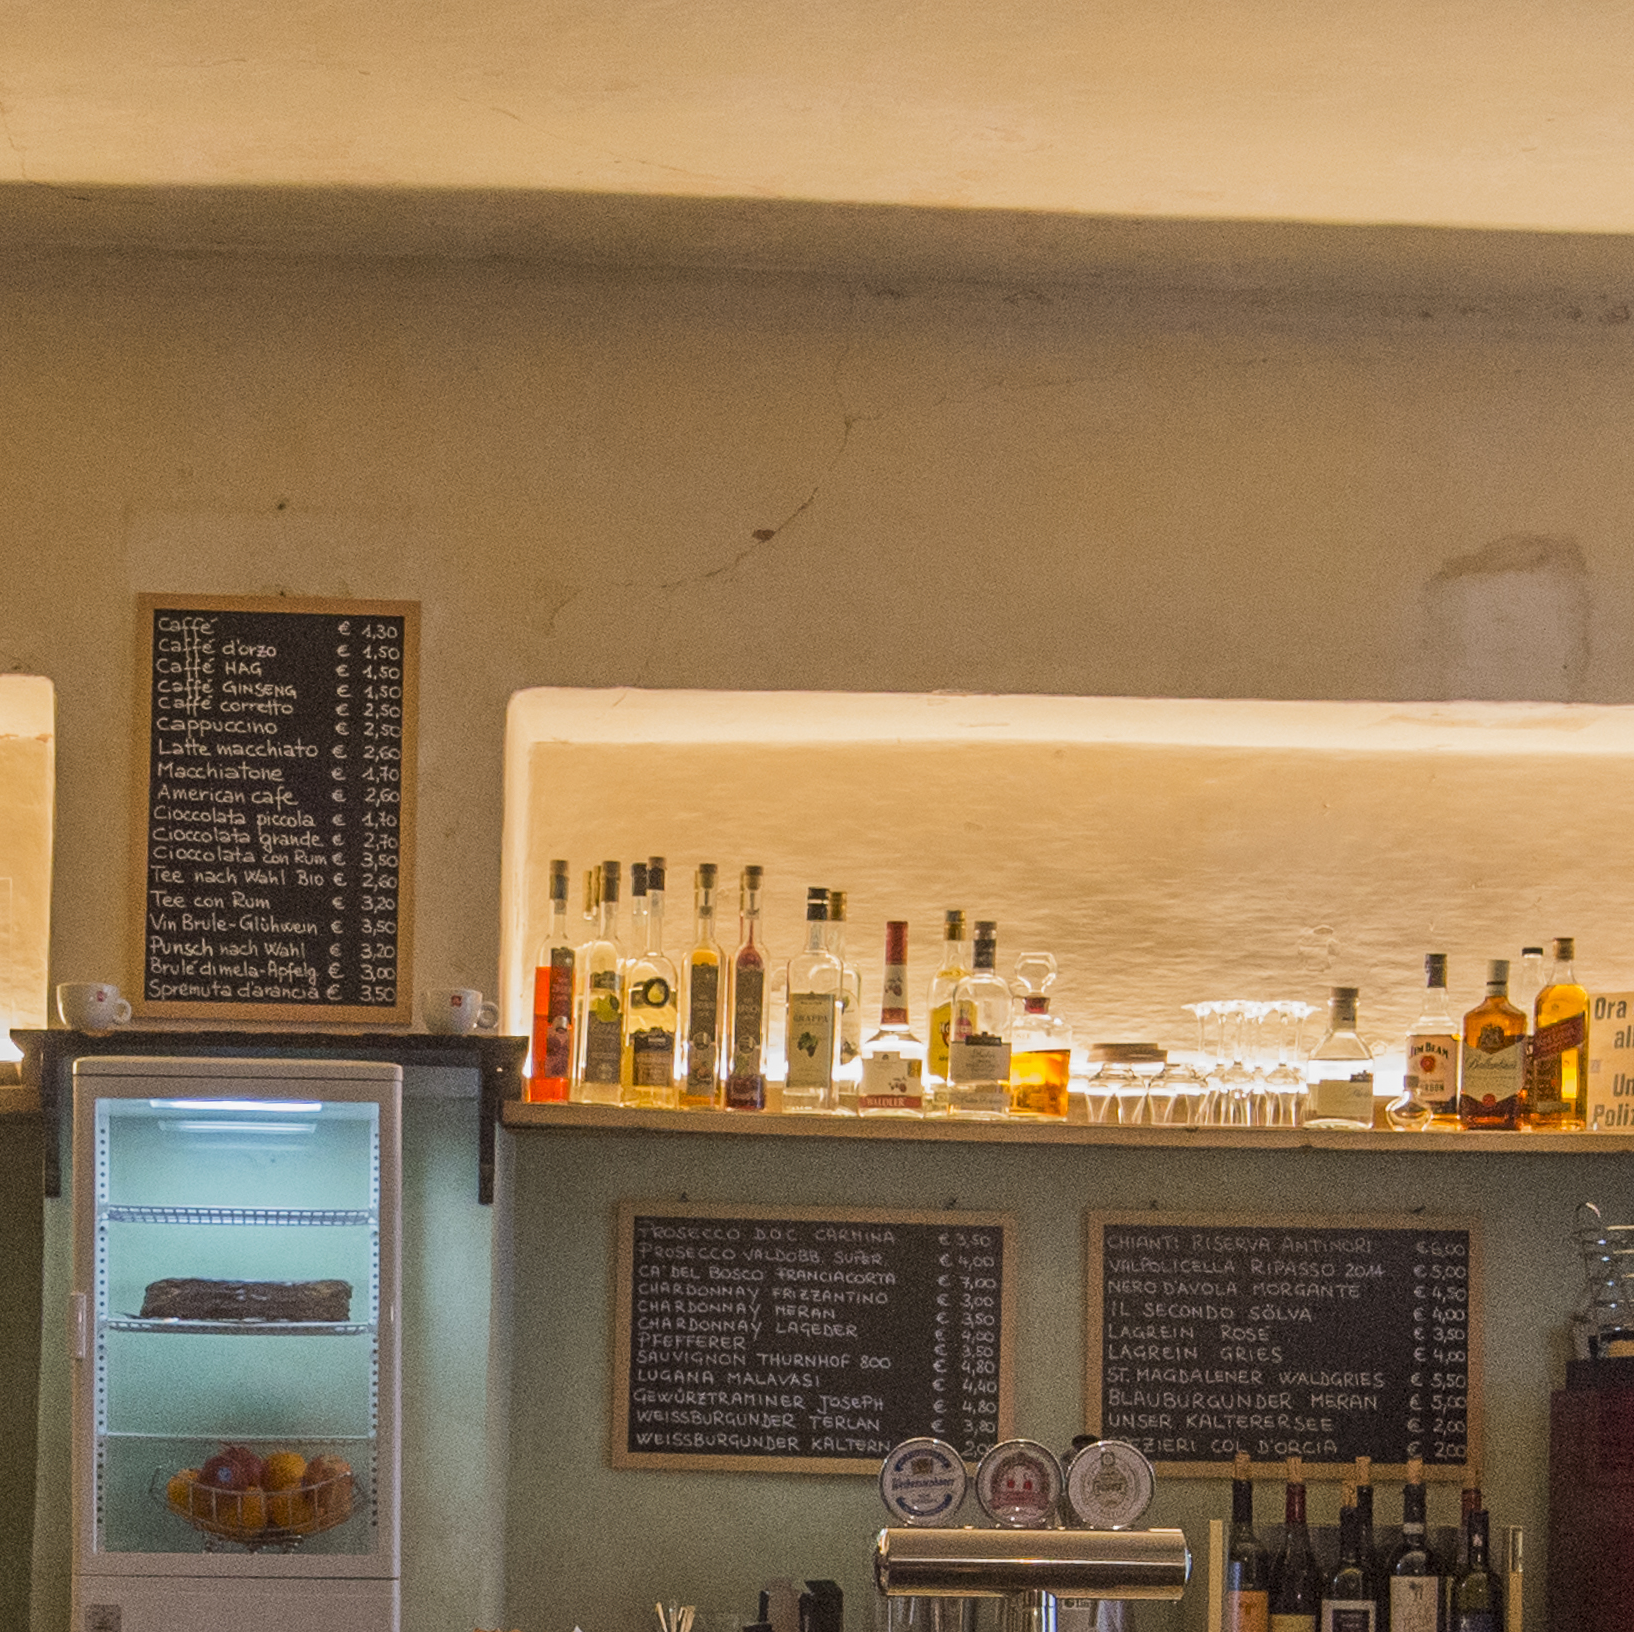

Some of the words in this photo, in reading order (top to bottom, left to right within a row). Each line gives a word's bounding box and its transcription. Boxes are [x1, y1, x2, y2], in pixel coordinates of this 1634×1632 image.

[361, 624, 398, 639] 1,30
[222, 640, 277, 657] d'orzo
[363, 645, 400, 660] 1,50
[225, 661, 262, 677] HAG
[363, 664, 400, 680] 1,50
[222, 681, 297, 699] GINSENG
[364, 685, 401, 700] 1,50
[220, 700, 294, 715] corretto
[364, 704, 401, 719] 2,50
[156, 717, 278, 737] Cappuccino
[364, 722, 401, 739] 2,50
[158, 739, 211, 756] Latte
[216, 738, 319, 758] macchiato
[363, 745, 401, 762] 2,60
[157, 761, 285, 782] Macchiatone
[362, 766, 399, 783] 1,70
[157, 784, 246, 804] American
[365, 788, 400, 807] 2,60
[153, 805, 246, 825] Cioccolata
[257, 810, 315, 835] piccola
[362, 811, 397, 828] 1,70
[153, 827, 251, 843] Cioccolata
[259, 831, 324, 853] grande
[364, 831, 397, 850] 2,70
[153, 846, 256, 863] Cioccolata
[262, 852, 289, 865] con
[294, 851, 327, 865] Rum
[361, 852, 398, 871] 3,50
[150, 865, 185, 883] Tee
[194, 867, 237, 884] nach
[244, 869, 285, 885] Wahl
[362, 873, 398, 892] 2,60
[150, 889, 186, 908] Tee
[194, 895, 224, 908] con
[232, 891, 270, 908] Rum
[361, 896, 395, 914] 3,20
[150, 913, 177, 931] Vin
[362, 917, 396, 936] 3,50
[150, 936, 213, 957] Punsch
[219, 939, 258, 956] nach
[264, 942, 305, 957] Wahl
[360, 943, 395, 960] 3,20
[360, 964, 395, 982] 3,00
[149, 979, 232, 1000] Spremuta
[360, 984, 396, 1002] 3,50
[1594, 996, 1627, 1020] Ora
[639, 1243, 736, 1261] PROSECCO
[671, 1266, 700, 1280] DEL
[709, 1267, 764, 1281] BOSCO
[777, 1268, 897, 1285] FRANCIACORTA
[638, 1282, 759, 1304] CHARDONNAY
[772, 1288, 889, 1305] FRIZZANTINO
[638, 1300, 761, 1322] CHARDONNAY
[775, 1305, 836, 1319] MERAN
[637, 1317, 762, 1340] CHARDONNAY
[776, 1322, 858, 1338] LAGEDER
[1108, 1324, 1194, 1339] LAGREIN
[639, 1333, 746, 1350] PFEFFERER
[637, 1352, 747, 1366] SAUVIGNON
[757, 1353, 850, 1369] THURNHOF
[860, 1357, 891, 1370] 800
[1108, 1345, 1198, 1361] LAGREIN
[1220, 1346, 1283, 1364] GRIES
[637, 1369, 714, 1384] LUGANA
[728, 1373, 820, 1388] MALAVASI
[1136, 1368, 1263, 1385] MAGDALENER
[1279, 1371, 1385, 1389] WALDGRIES
[1109, 1389, 1293, 1410] BLAUBURGUNDER
[1310, 1393, 1378, 1410] MERAN
[637, 1410, 796, 1429] WEISSBURGUNDER
[809, 1415, 880, 1431] TERLAN
[1109, 1413, 1172, 1429] UNSER
[637, 1433, 800, 1449] WEISSBURGUNDER
[812, 1437, 891, 1452] KALTERN
